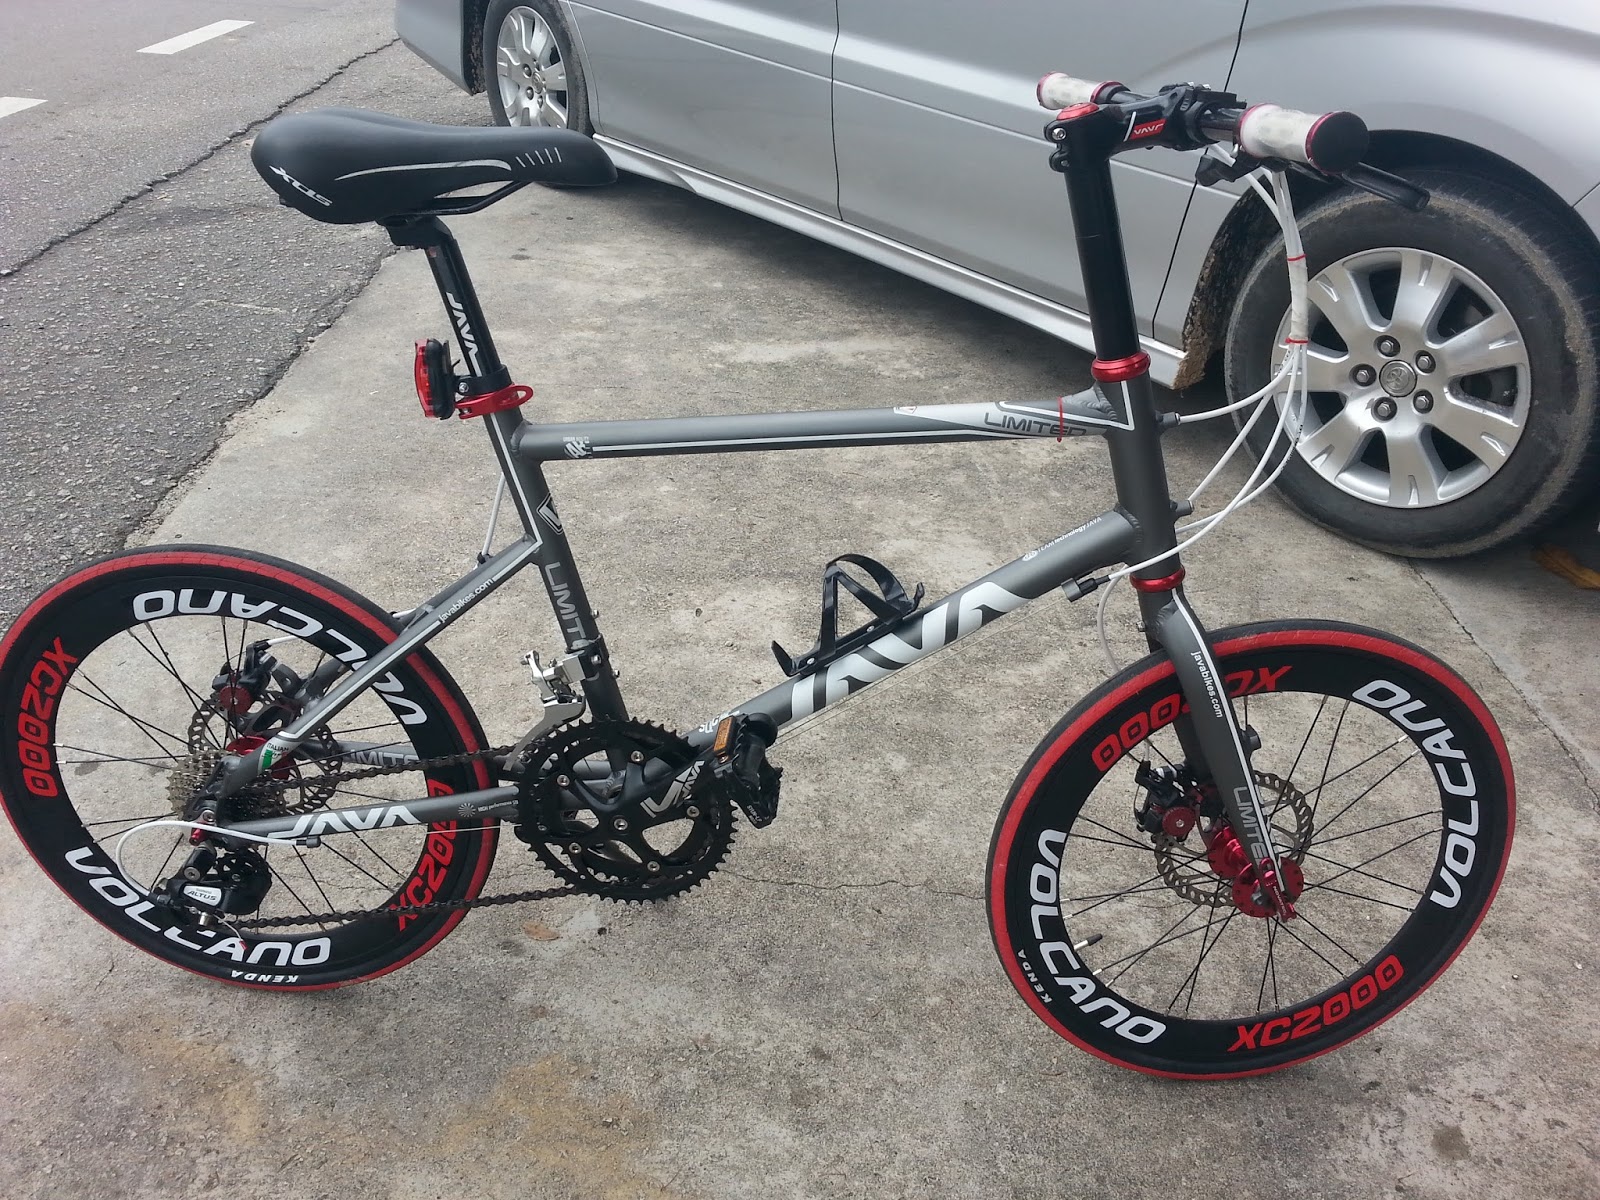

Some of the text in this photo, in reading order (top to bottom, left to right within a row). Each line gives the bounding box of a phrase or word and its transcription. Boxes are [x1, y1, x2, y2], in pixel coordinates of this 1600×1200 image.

[446, 292, 483, 377] JAVA
[984, 412, 1087, 437] LIMITED
[438, 578, 495, 624] javabikes.com
[545, 561, 589, 649] LIMIT
[791, 581, 1032, 722] JAVA
[1190, 650, 1224, 718] javabikes.com
[17, 635, 79, 798] XC2000
[1091, 665, 1294, 772] XC000
[267, 805, 422, 839] JAVA
[1233, 786, 1269, 862] LIMITE
[1351, 679, 1480, 909] VOLCANO
[187, 890, 218, 901] ALTUS
[231, 969, 299, 983] KENDA
[1016, 948, 1053, 1004] KENDA
[1029, 828, 1167, 1044] VOLCANO
[1227, 953, 1405, 1053] XC2000
